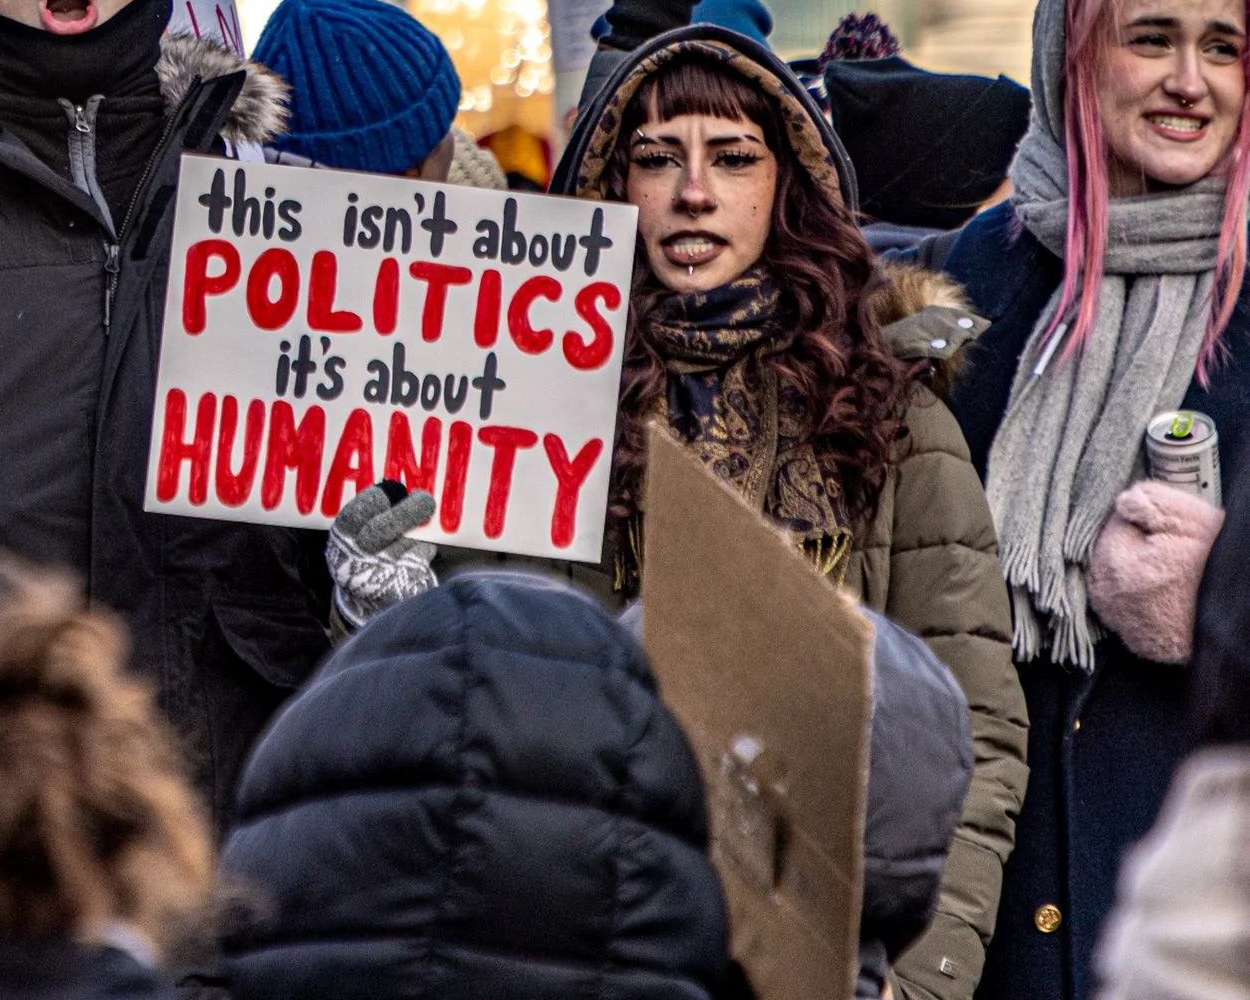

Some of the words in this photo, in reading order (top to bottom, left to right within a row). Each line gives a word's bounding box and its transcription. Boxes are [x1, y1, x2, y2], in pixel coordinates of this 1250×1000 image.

[198, 167, 302, 242] this
[343, 189, 457, 258] isn't
[472, 197, 613, 277] about
[182, 238, 622, 371] POLITICS
[275, 334, 347, 401] it's
[363, 342, 507, 421] about
[155, 388, 604, 549] HUMANITY
